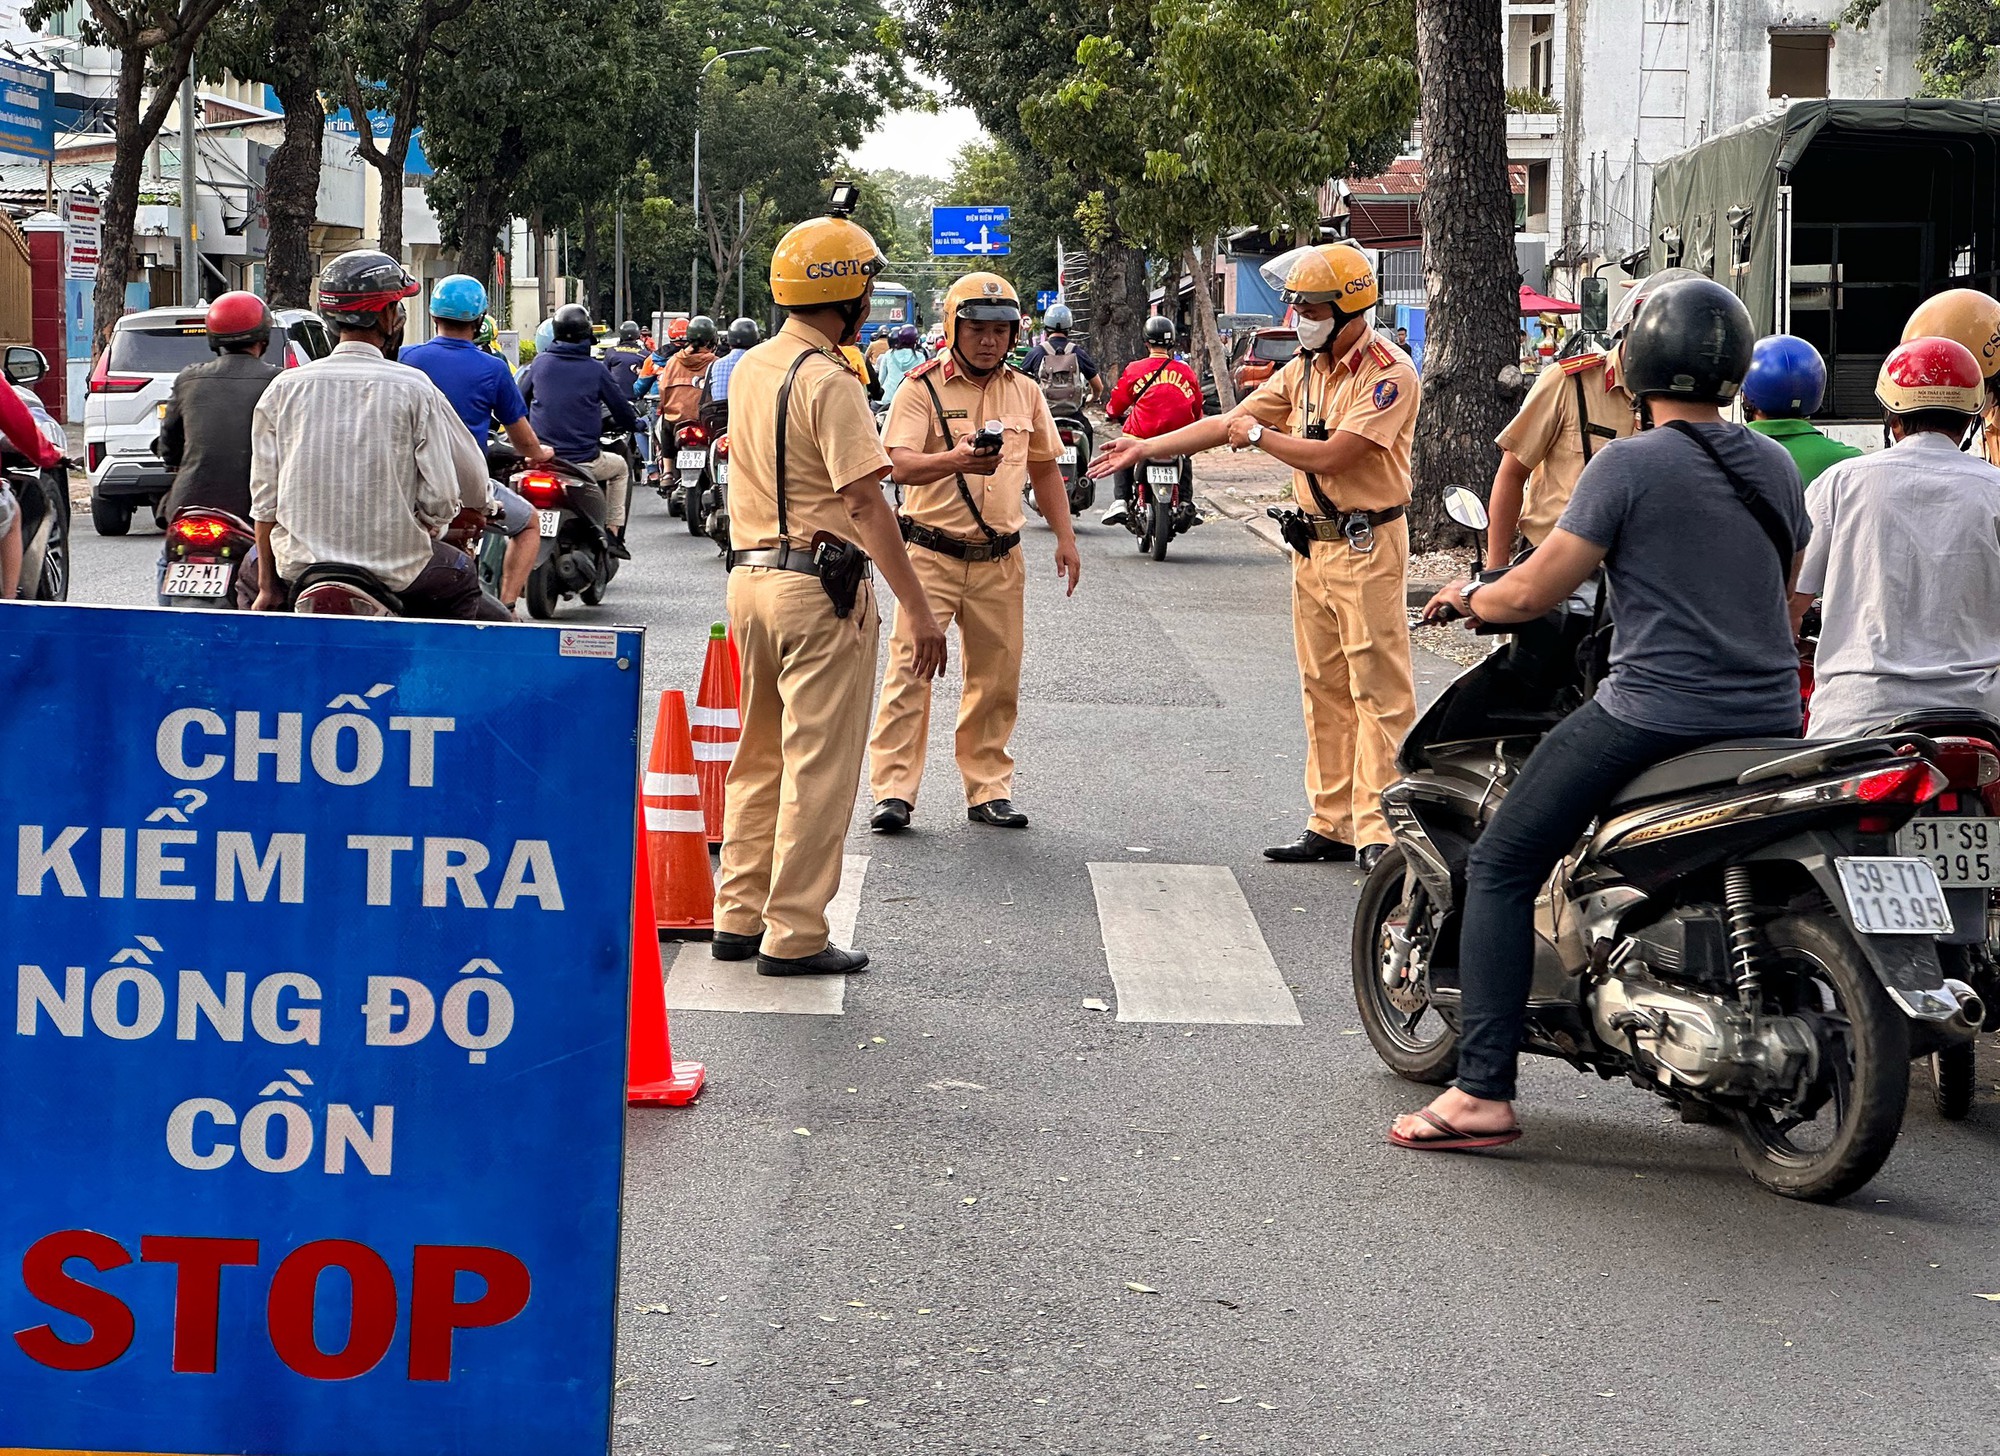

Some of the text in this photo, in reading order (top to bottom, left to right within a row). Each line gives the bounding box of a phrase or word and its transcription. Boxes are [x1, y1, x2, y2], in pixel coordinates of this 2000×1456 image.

[806, 259, 860, 280] CSGT
[891, 309, 902, 318] 18
[177, 565, 220, 579] 37-N1
[168, 580, 222, 595] 202.22
[156, 683, 455, 787] CHỐT
[1666, 808, 1732, 831] BLADE
[17, 788, 565, 911] KIỂM TRA
[1912, 823, 1988, 850] 51-S9
[1853, 864, 1923, 894] 59-T1
[1917, 854, 1990, 881] 395
[1856, 897, 1944, 928] 113.95
[17, 935, 514, 1064] NỒNG ĐỘ
[166, 1069, 394, 1176] CỒN
[13, 1229, 531, 1382] STOP
